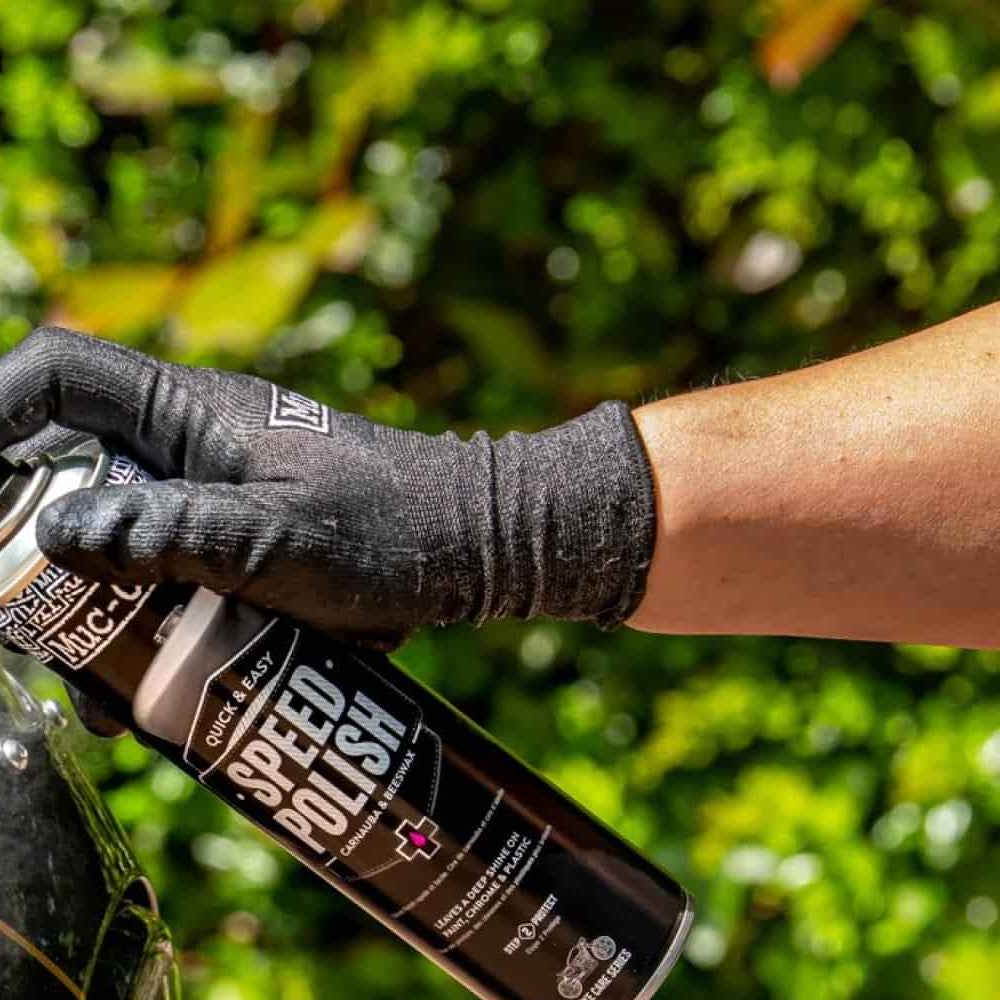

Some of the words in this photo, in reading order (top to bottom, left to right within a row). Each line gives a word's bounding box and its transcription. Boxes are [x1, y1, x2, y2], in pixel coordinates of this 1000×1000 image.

[48, 583, 142, 663] Muc-
[205, 702, 238, 747] QUICK
[232, 687, 248, 702] &
[242, 650, 274, 691] EASY
[227, 665, 346, 807] SPEED
[273, 690, 407, 854] POLISH
[340, 810, 381, 857] CARNAUBA
[378, 800, 388, 812] &
[384, 750, 417, 801] BEESWAX
[434, 904, 462, 930] LEAVES
[466, 876, 488, 900] DEEP
[486, 847, 511, 877] SHINE
[507, 831, 520, 848] ON
[465, 881, 501, 919] CHROME
[503, 836, 531, 874] PLASTIC
